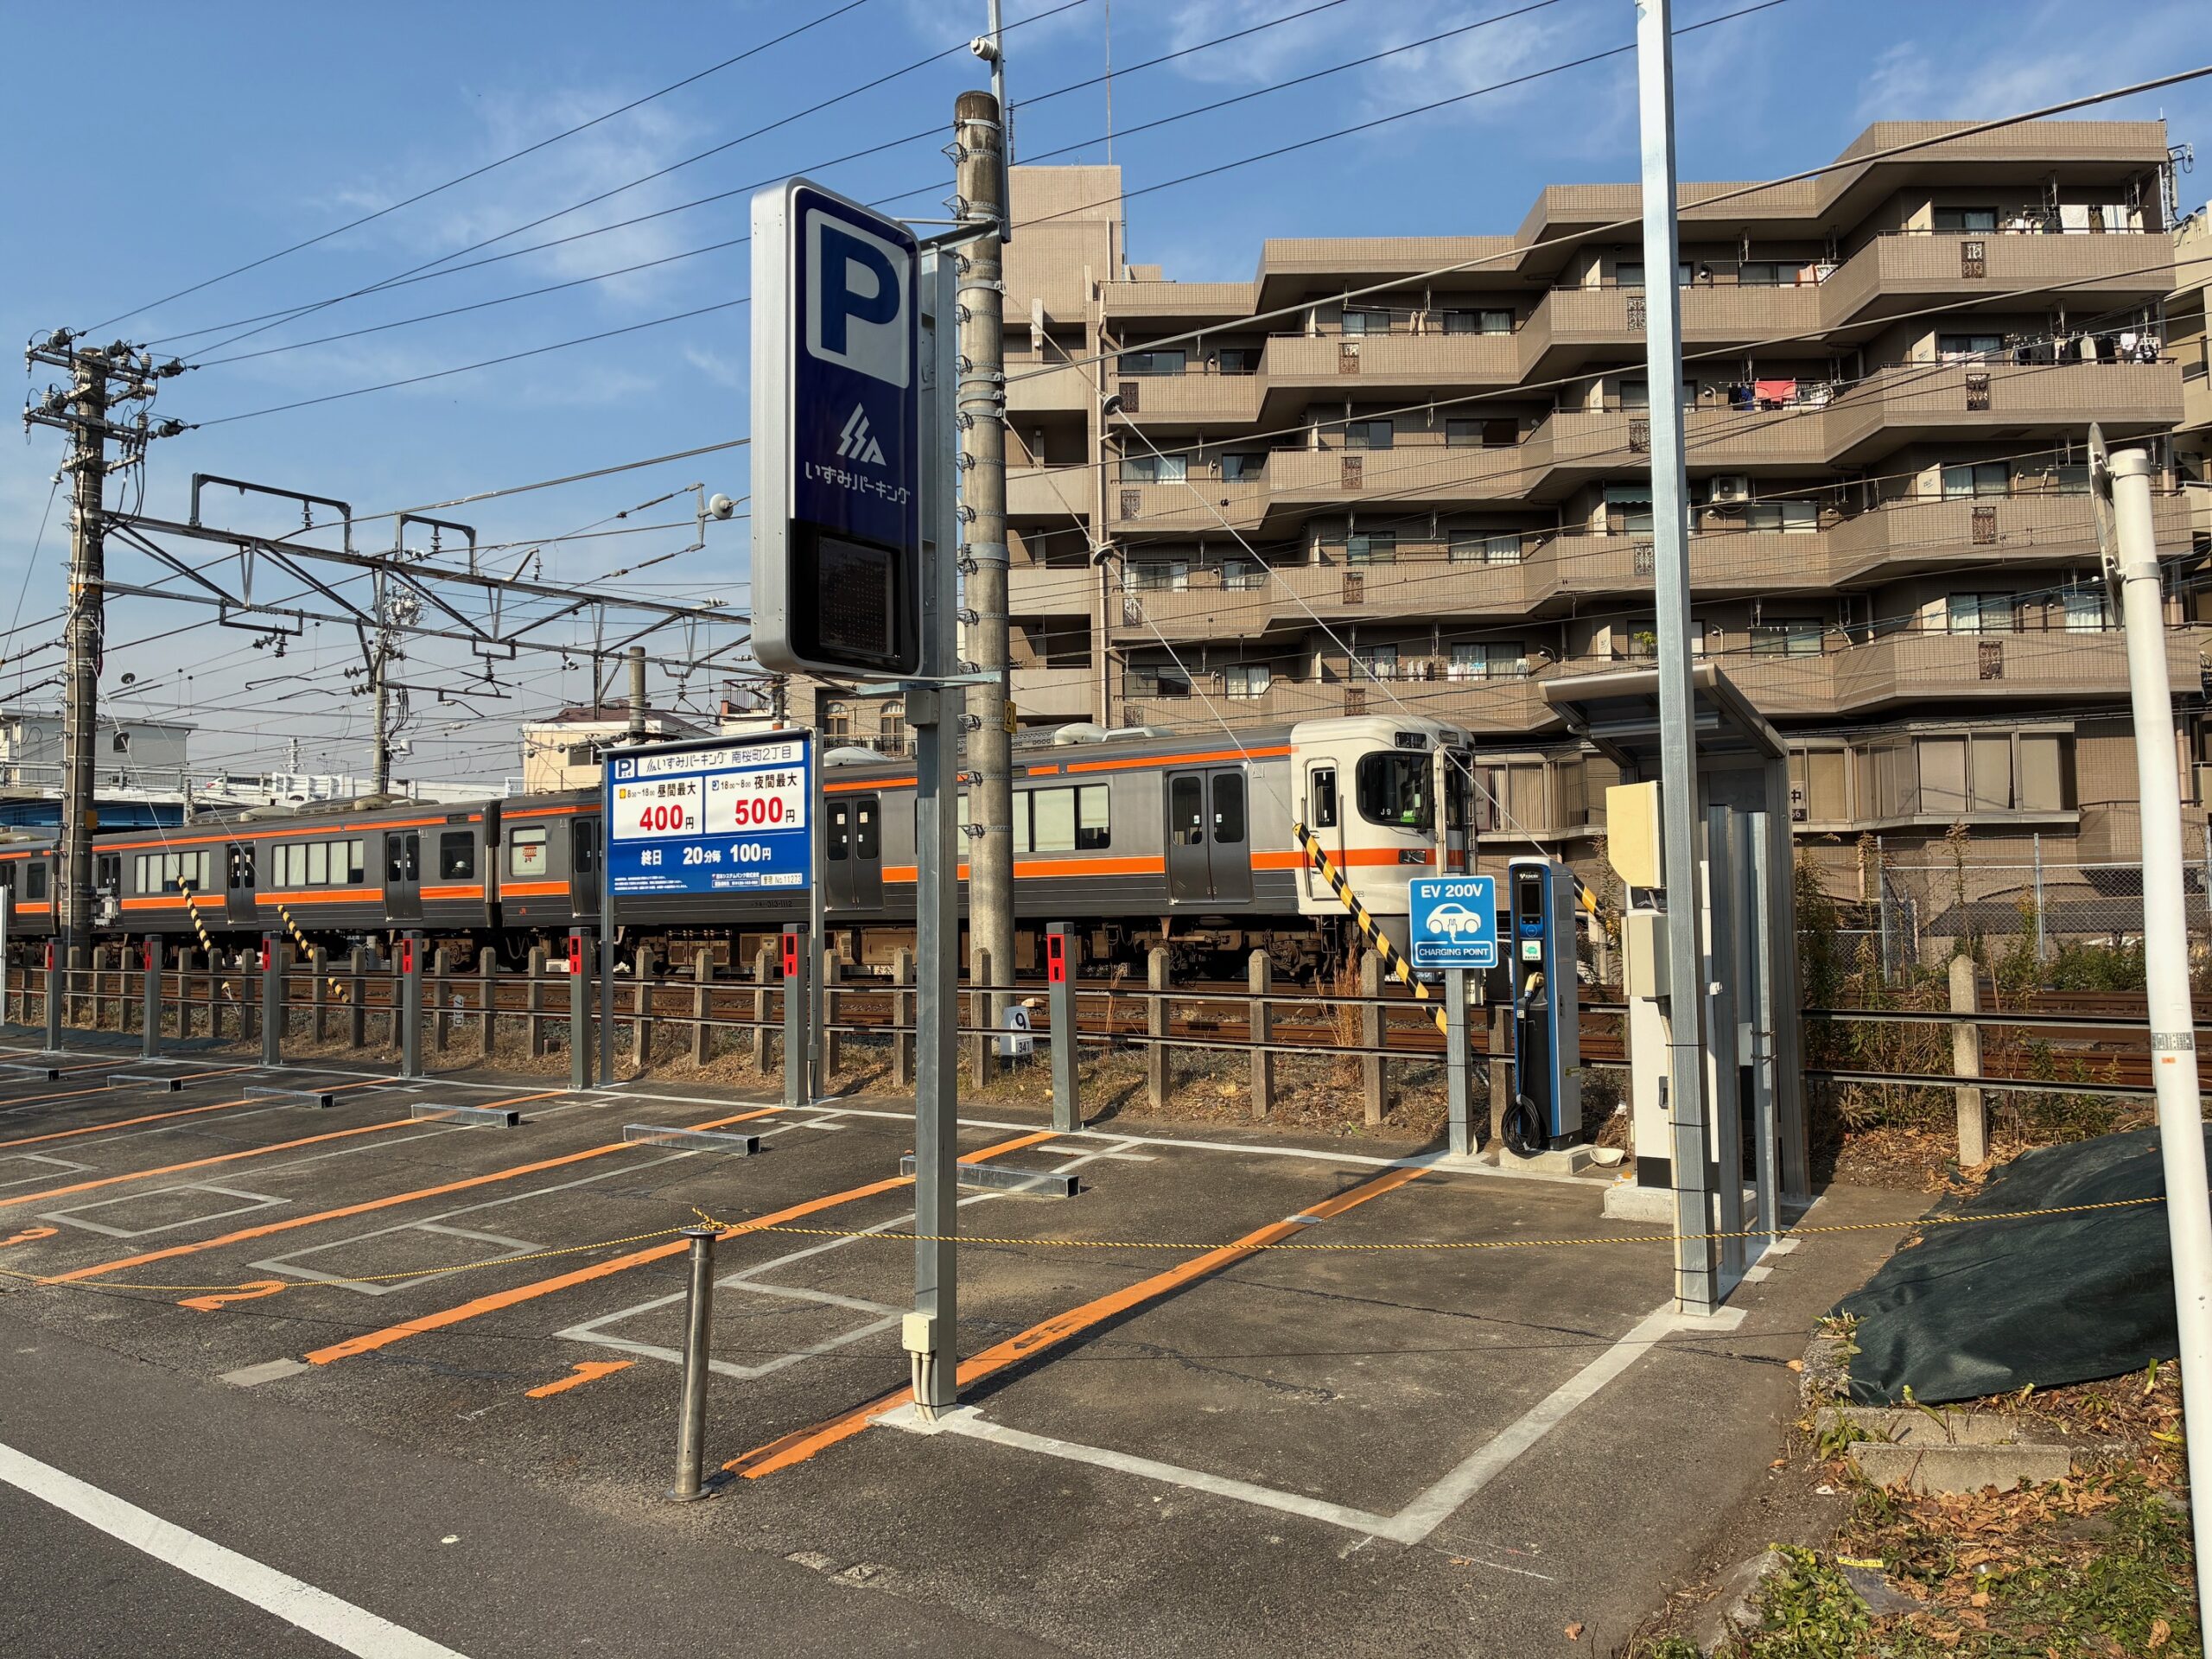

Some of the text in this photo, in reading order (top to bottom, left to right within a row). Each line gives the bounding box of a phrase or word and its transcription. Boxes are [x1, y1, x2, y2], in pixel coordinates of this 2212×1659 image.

[821, 224, 900, 356] P
[805, 461, 911, 505] いずみパーキング
[658, 746, 791, 770] いずみパーキング 南桜町2丁目
[618, 760, 632, 778] P
[658, 781, 696, 798] 昼間最大
[754, 772, 797, 790] 夜間最大
[1791, 790, 1801, 804] 中
[639, 804, 694, 831] 400円
[735, 796, 795, 825] 500円
[641, 843, 772, 866] 終日 20分毎 100円
[1421, 883, 1483, 899] EV 200V
[1420, 947, 1490, 957] CHARGING POINT
[1015, 1013, 1027, 1030] 9
